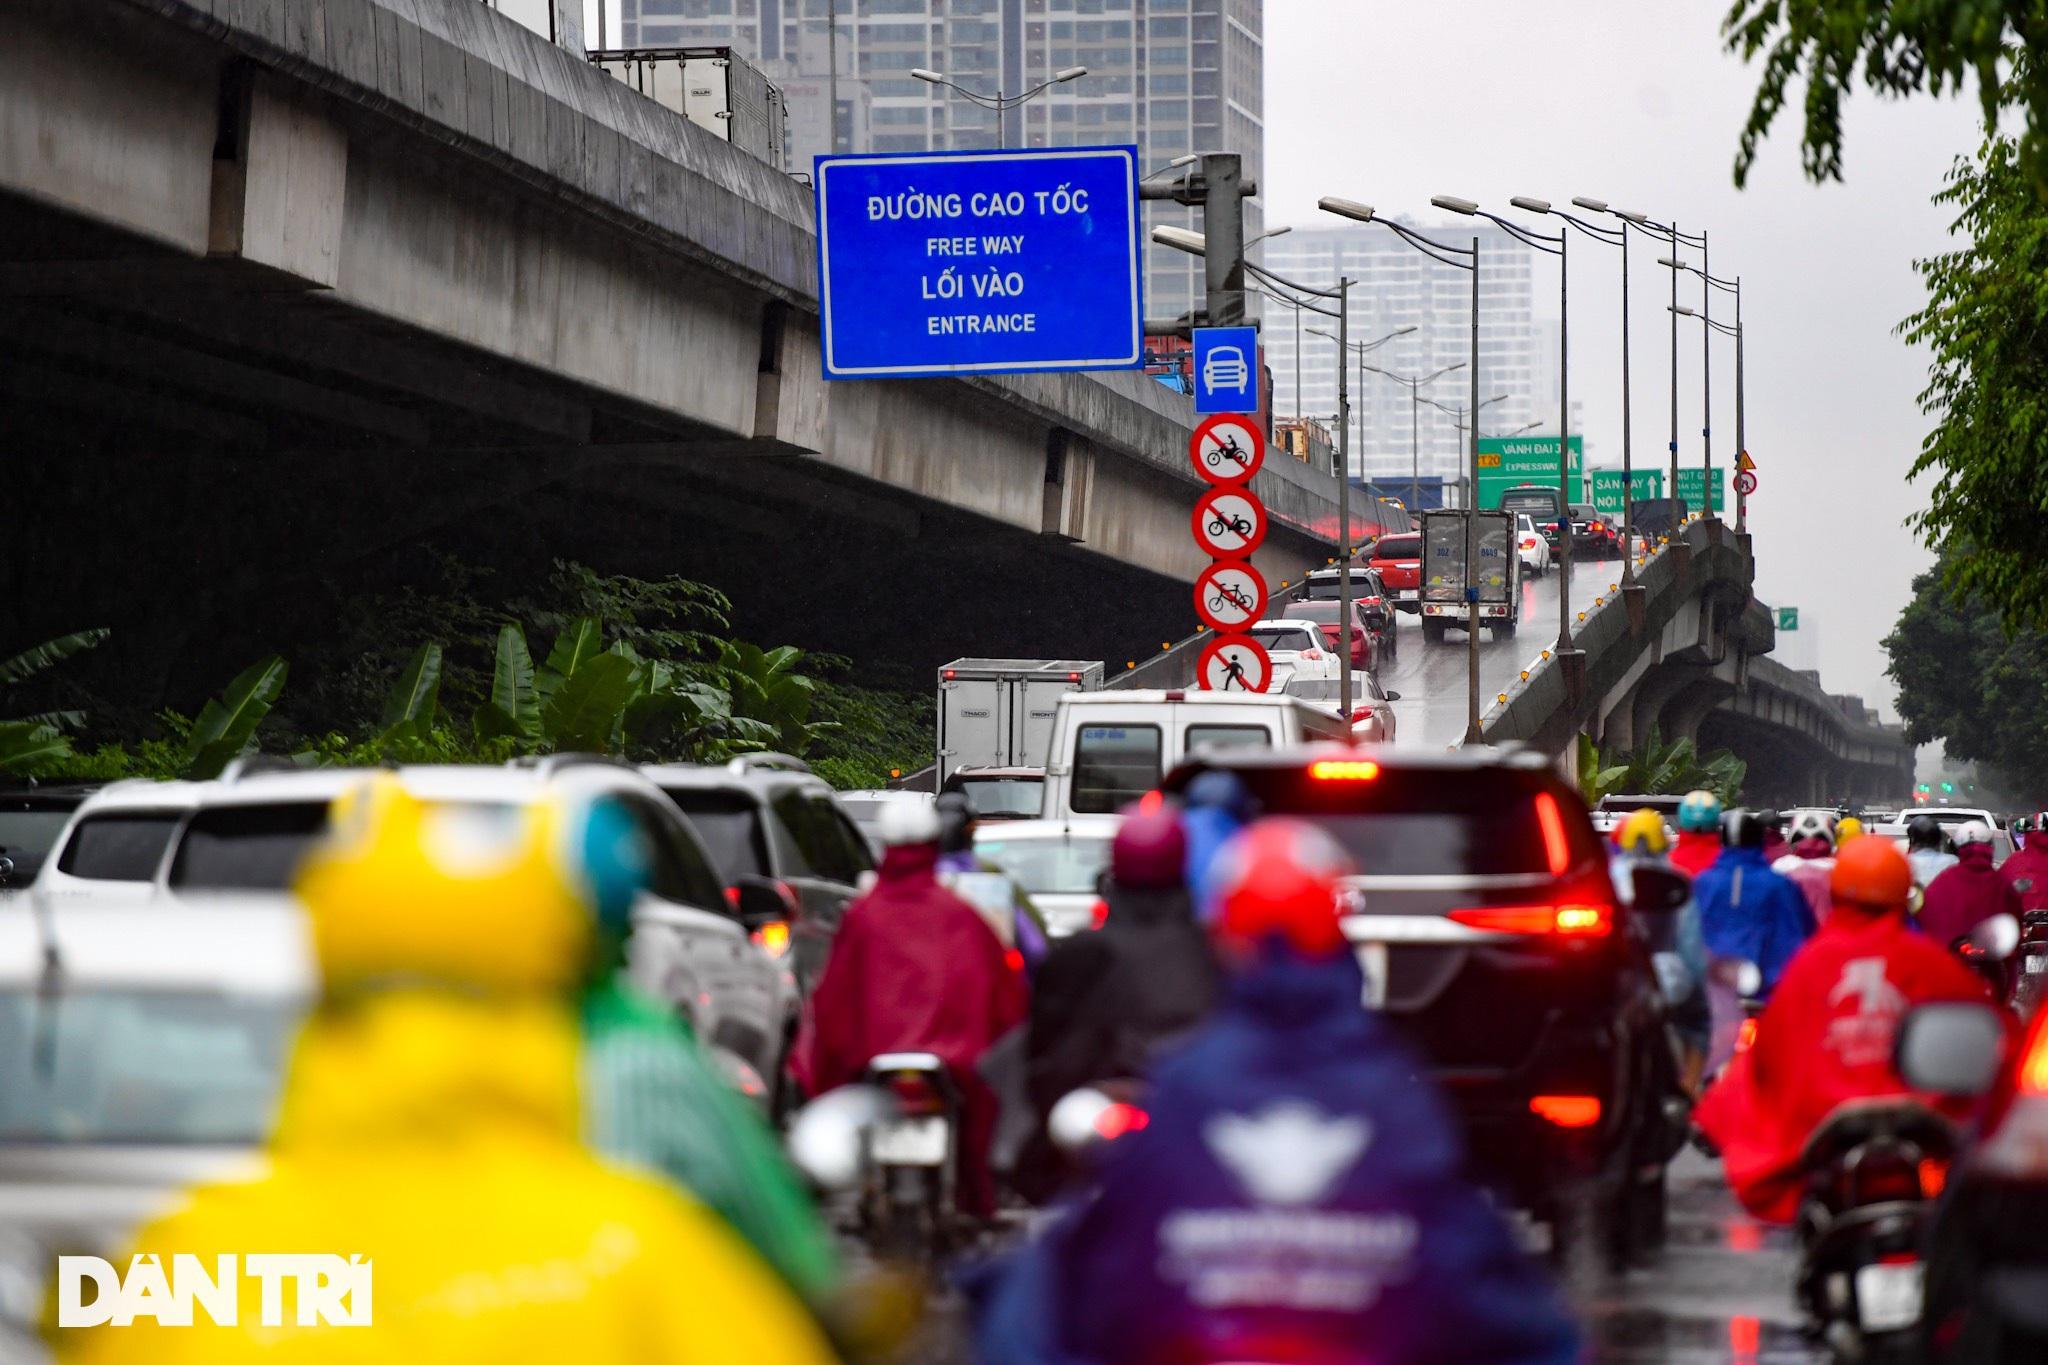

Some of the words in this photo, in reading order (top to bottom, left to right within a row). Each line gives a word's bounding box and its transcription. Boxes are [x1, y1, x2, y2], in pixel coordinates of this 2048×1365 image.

[867, 186, 962, 220] ĐƯỜNG
[970, 192, 1025, 217] CAO
[1034, 182, 1089, 215] TỐC
[927, 237, 977, 256] FREE
[982, 235, 1025, 255] WAY
[922, 265, 963, 299] LỐI
[971, 265, 1024, 298] VÀO
[928, 313, 1036, 335] ENTRANCE
[1502, 442, 1532, 454] VÀNH
